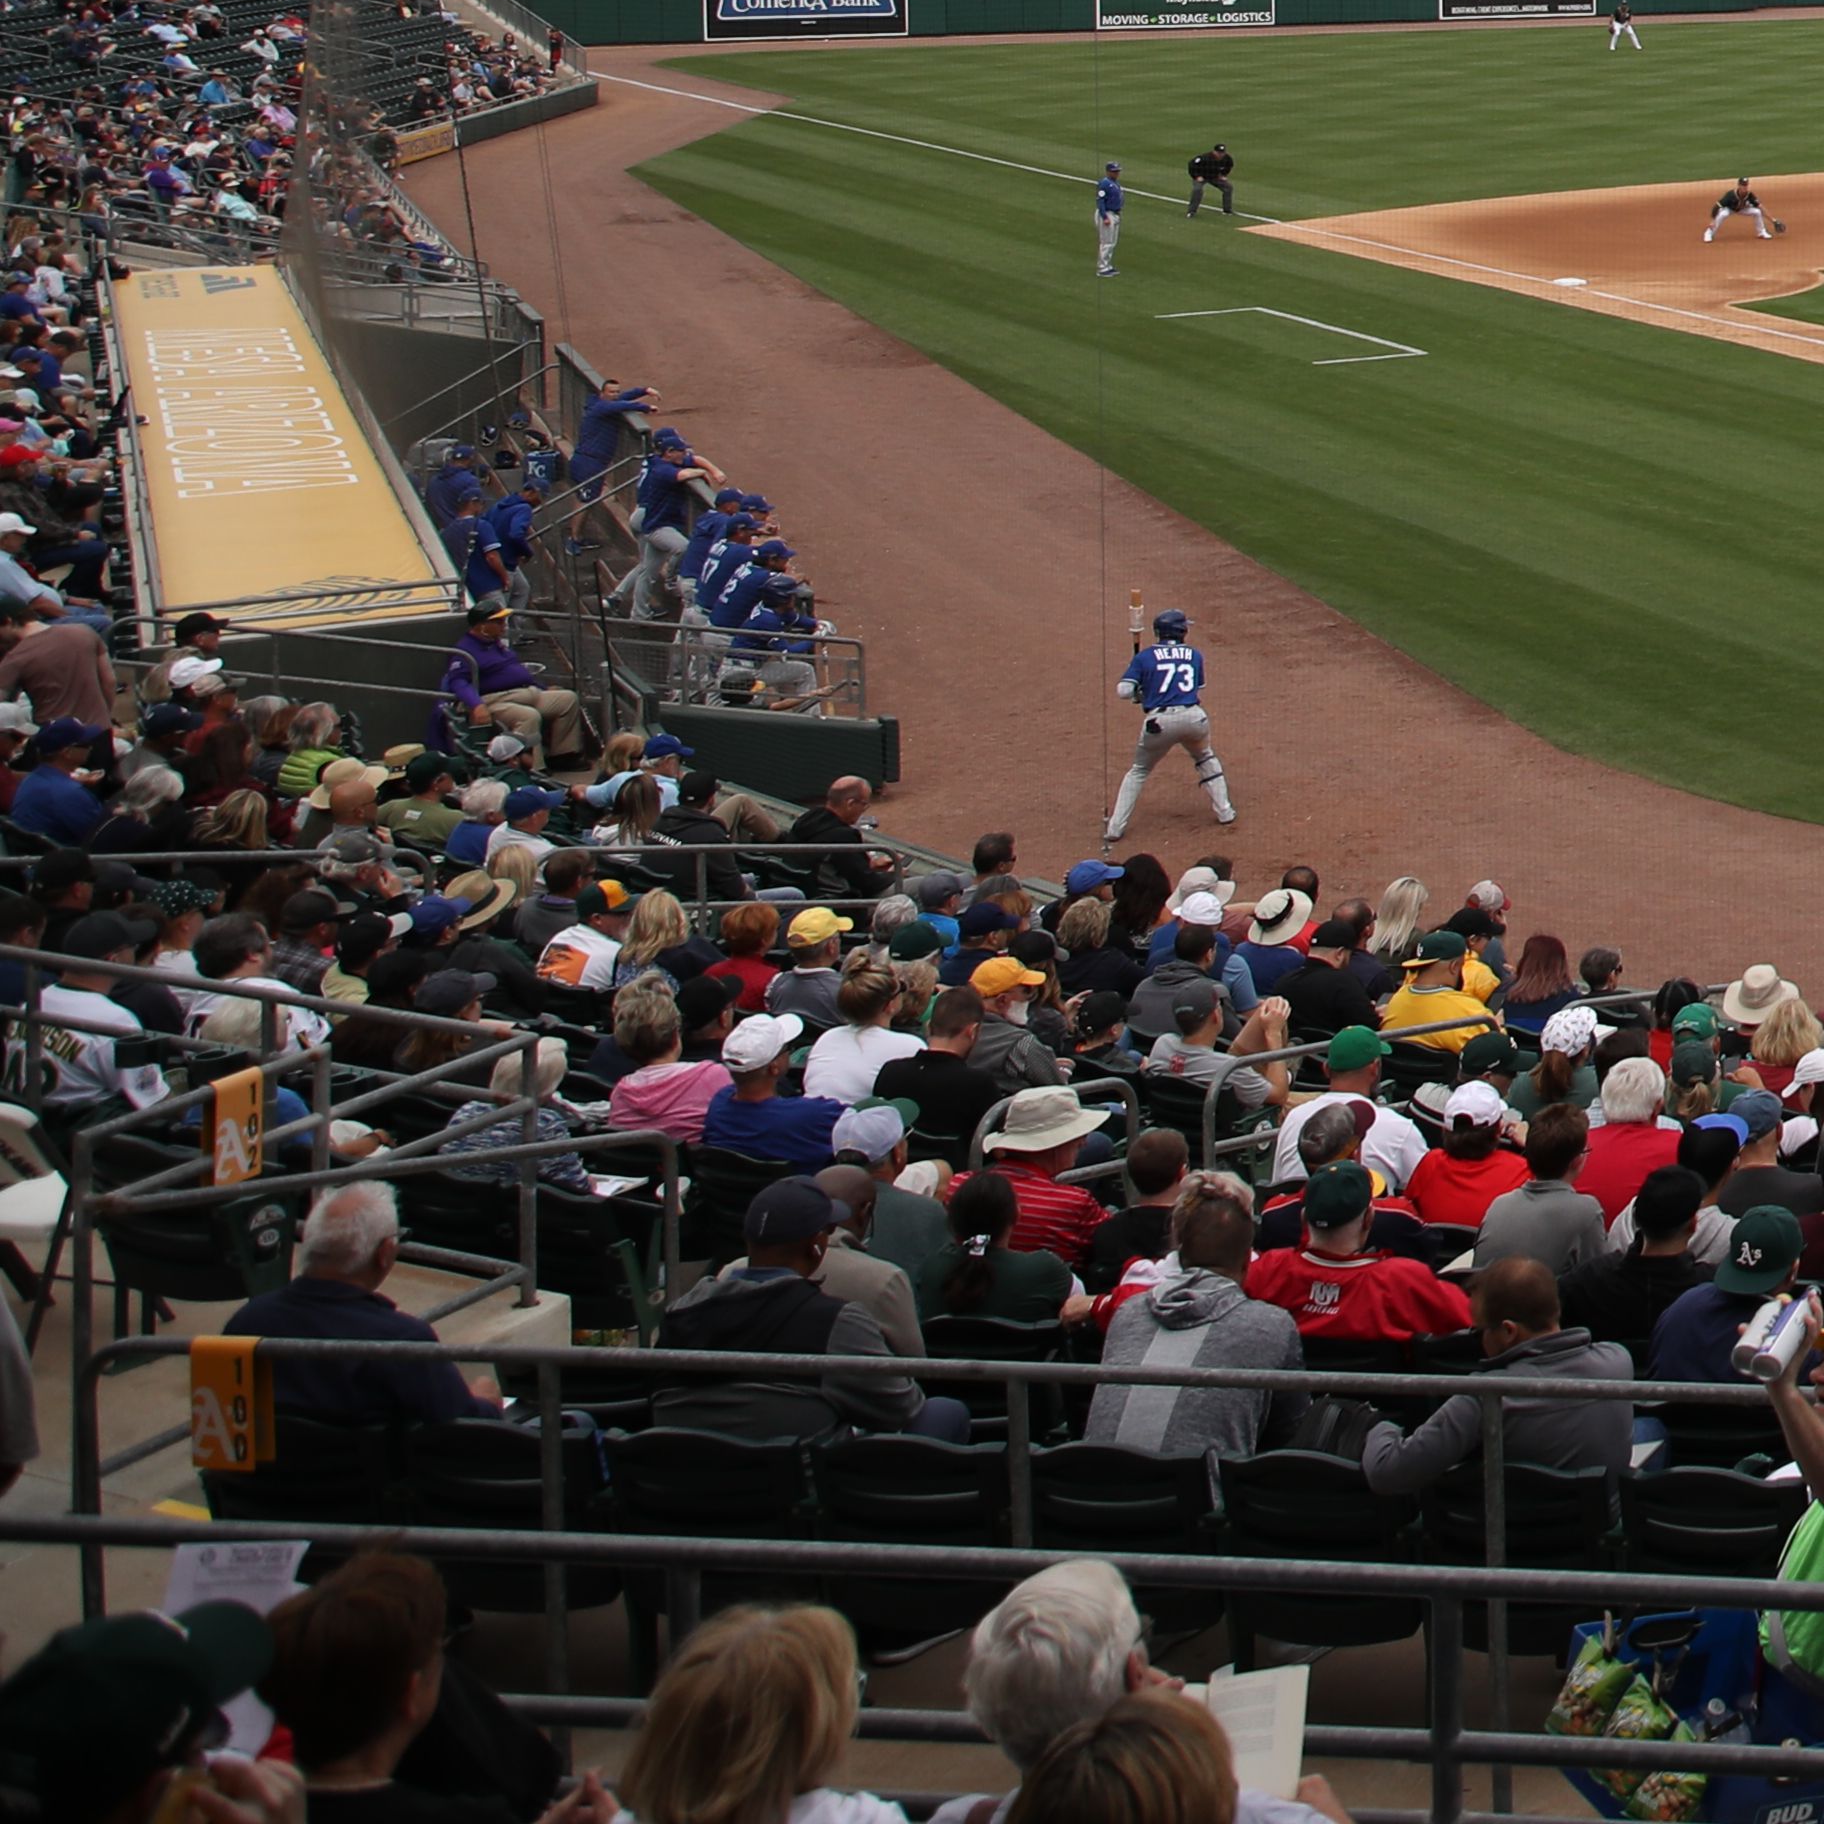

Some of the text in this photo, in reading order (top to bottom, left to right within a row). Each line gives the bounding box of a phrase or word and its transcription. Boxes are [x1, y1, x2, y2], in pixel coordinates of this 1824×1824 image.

[1102, 12, 1272, 25] MOVING STORAGE LOGISTICS
[145, 328, 358, 498] MESA ARIZONA
[528, 461, 546, 478] KC
[701, 557, 720, 584] 17
[1154, 647, 1192, 661] HEATH
[1156, 663, 1194, 693] 73
[249, 1081, 259, 1171] 102
[1736, 1241, 1762, 1266] A's
[234, 1356, 248, 1462] 100
[1767, 1802, 1814, 1824] BUD
